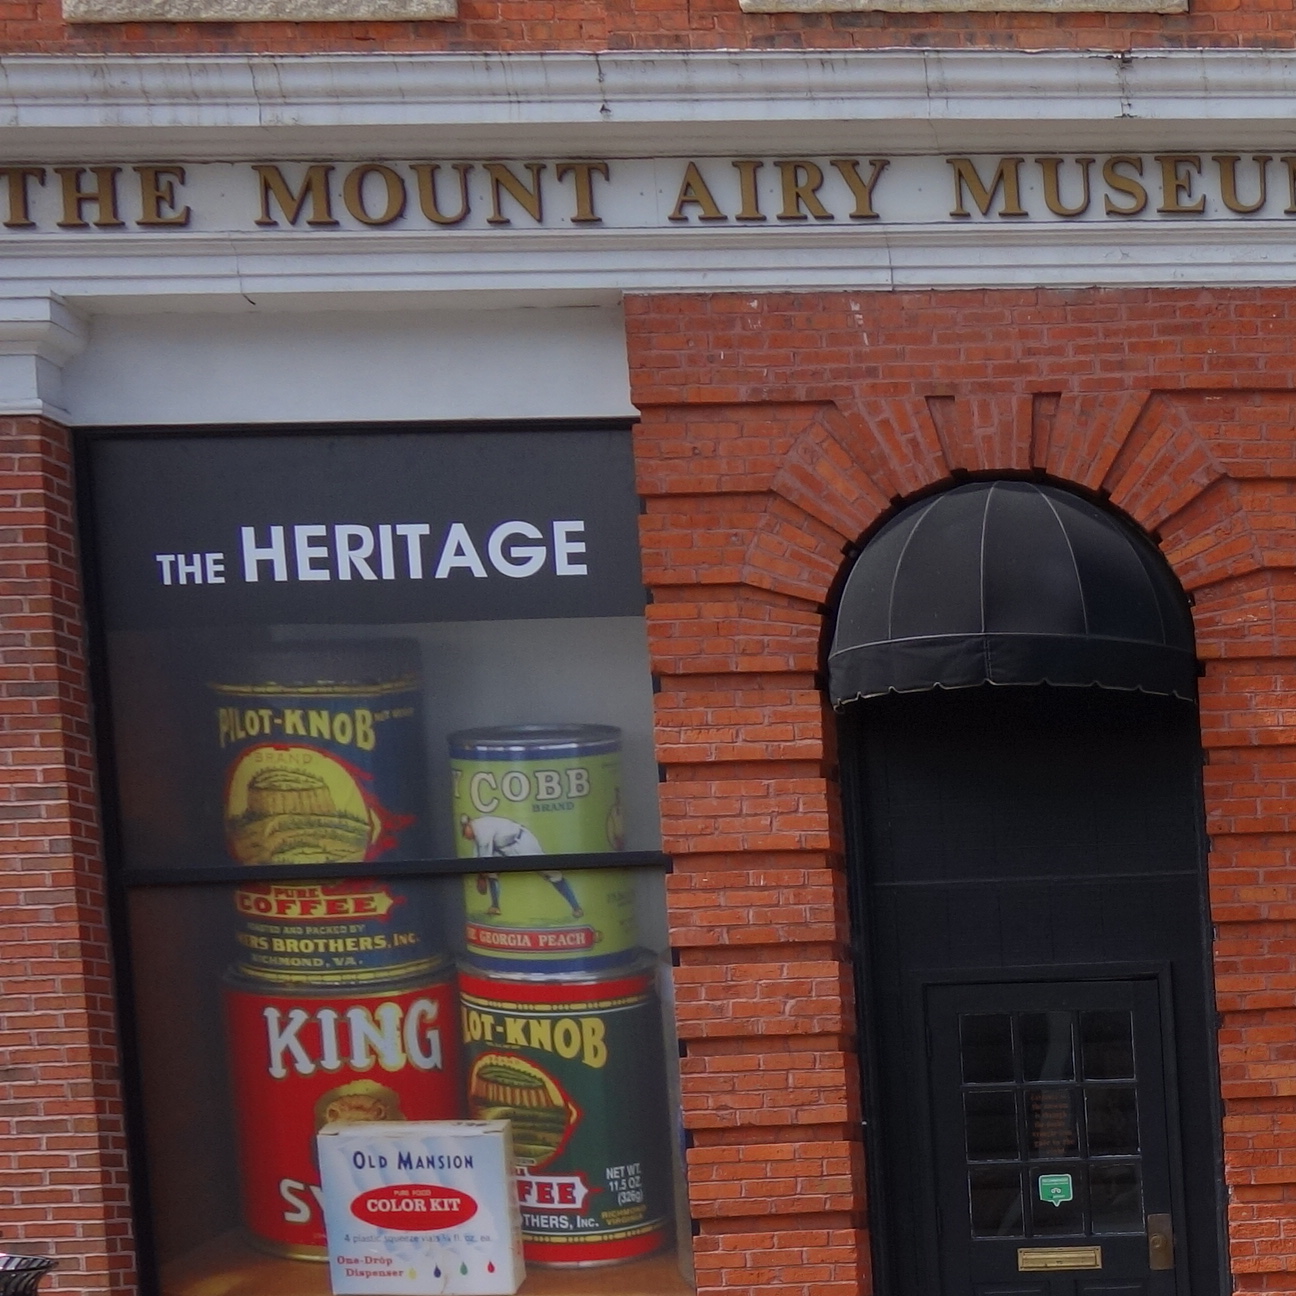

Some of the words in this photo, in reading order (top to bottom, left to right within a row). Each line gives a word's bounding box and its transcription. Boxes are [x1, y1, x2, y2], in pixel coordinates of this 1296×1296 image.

[0, 164, 191, 227] THE
[254, 161, 609, 226] MOUNT
[669, 158, 891, 221] AIRY
[156, 553, 225, 586] THE
[240, 519, 588, 582] HERITAGE
[219, 707, 376, 751] PILOT-KNOB
[470, 767, 591, 813] COBB
[532, 801, 575, 813] BRAND
[239, 896, 377, 916] COFFEE
[283, 926, 302, 934] AND
[305, 925, 347, 934] PACKED
[479, 931, 531, 946] GEORGIA
[538, 932, 586, 947] PEACH
[264, 998, 443, 1079] KING
[353, 1151, 387, 1170] OLD
[398, 1151, 474, 1170] MANSION
[605, 1166, 625, 1180] NET
[367, 1199, 427, 1212] COLOR
[430, 1198, 461, 1211] KIT
[337, 1256, 392, 1266] One-Drop
[346, 1268, 404, 1278] Dispenser
